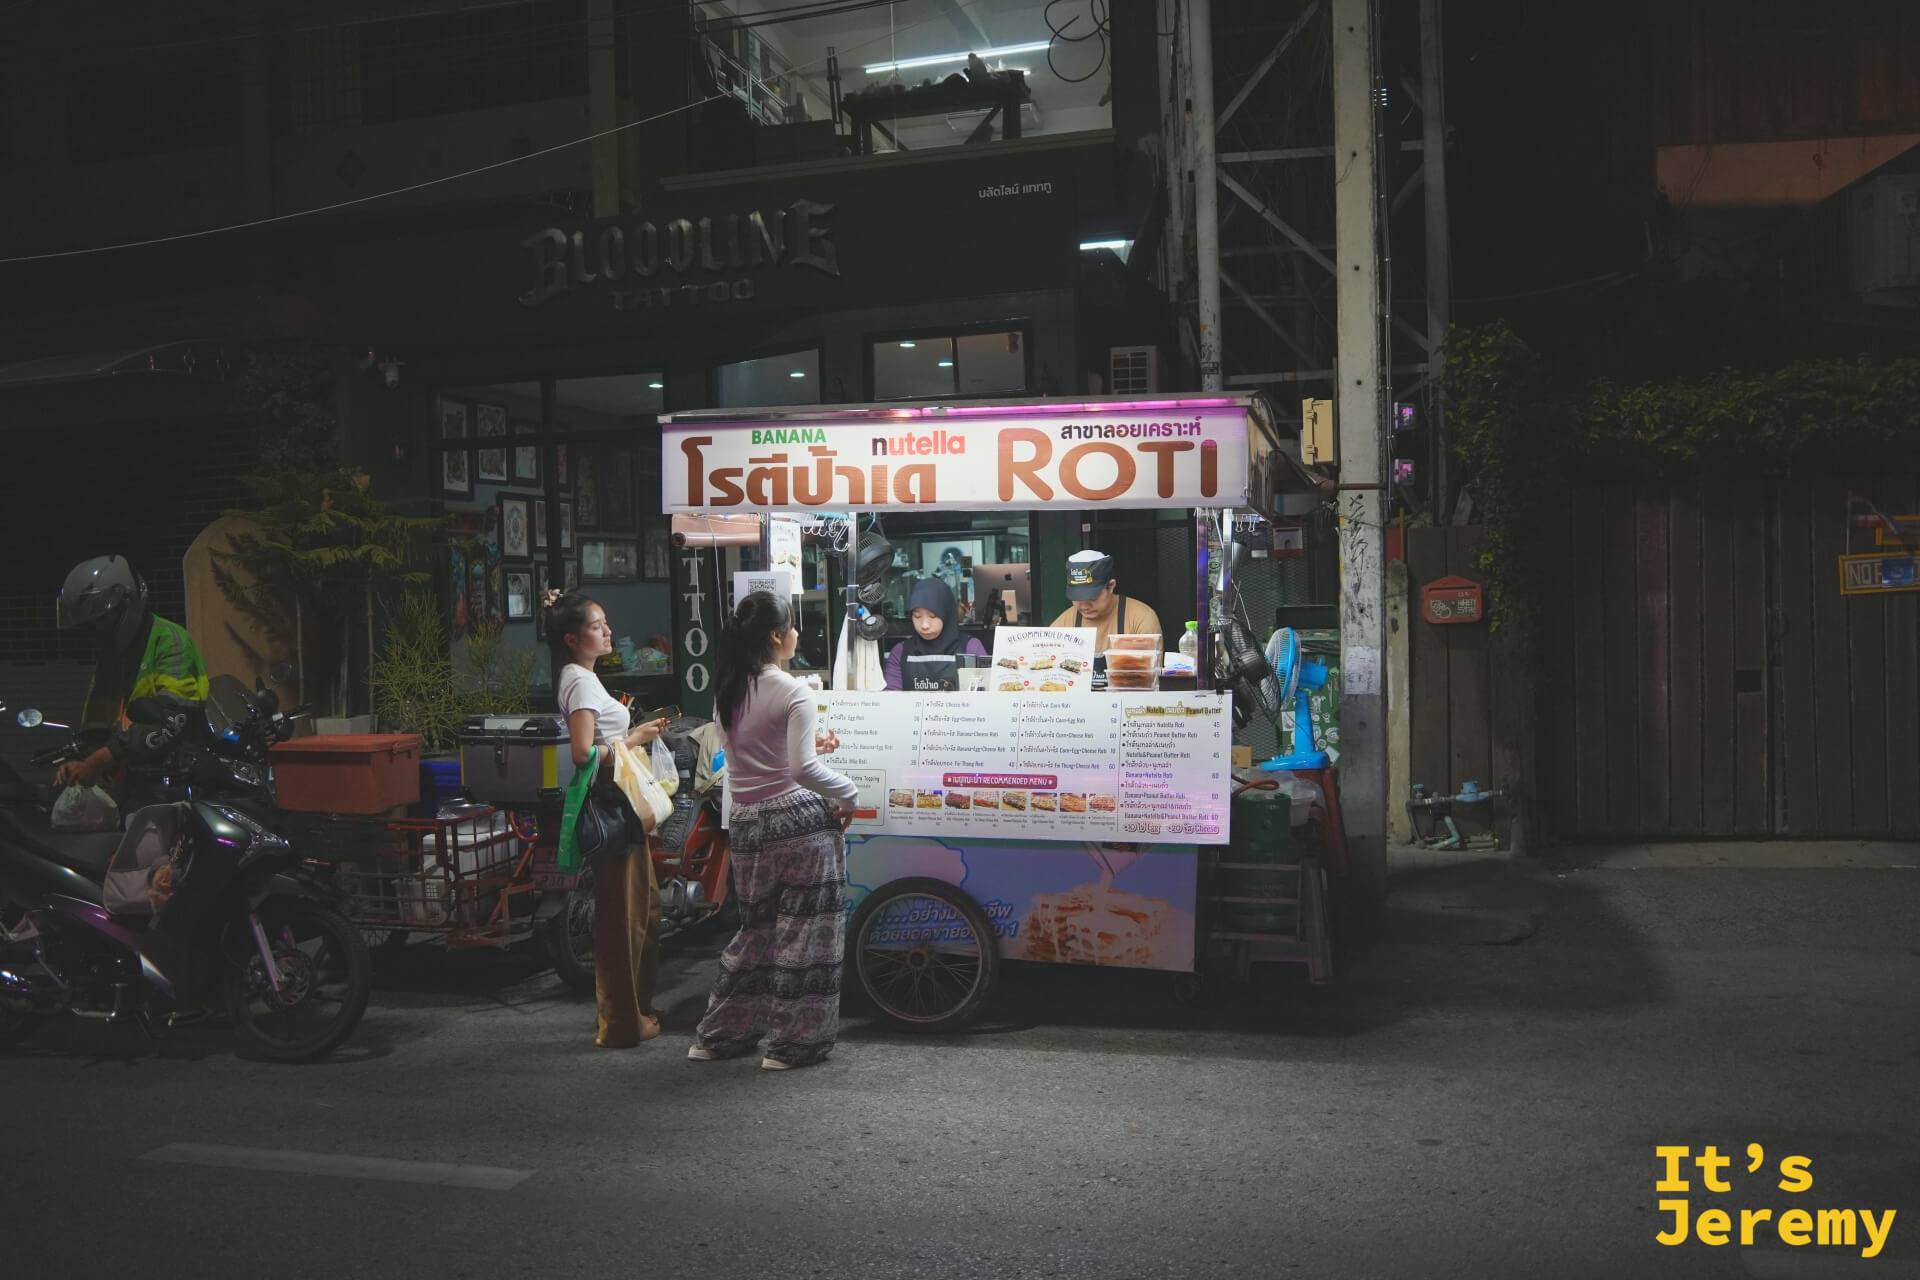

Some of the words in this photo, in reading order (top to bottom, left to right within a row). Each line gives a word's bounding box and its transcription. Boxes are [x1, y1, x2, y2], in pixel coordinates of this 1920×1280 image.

[978, 183, 1019, 199] บลัดไลน์
[515, 199, 840, 310] BLOODLINE
[608, 279, 755, 312] TATTOO
[751, 428, 827, 445] BANANA
[1061, 416, 1202, 440] สาขาลอยเคราะห์
[871, 430, 966, 456] nutella
[680, 436, 937, 506] โรตีป้าเด
[998, 427, 1218, 502] ROTI
[983, 777, 1028, 785] RECOMMENDED
[1029, 777, 1047, 786] MENU
